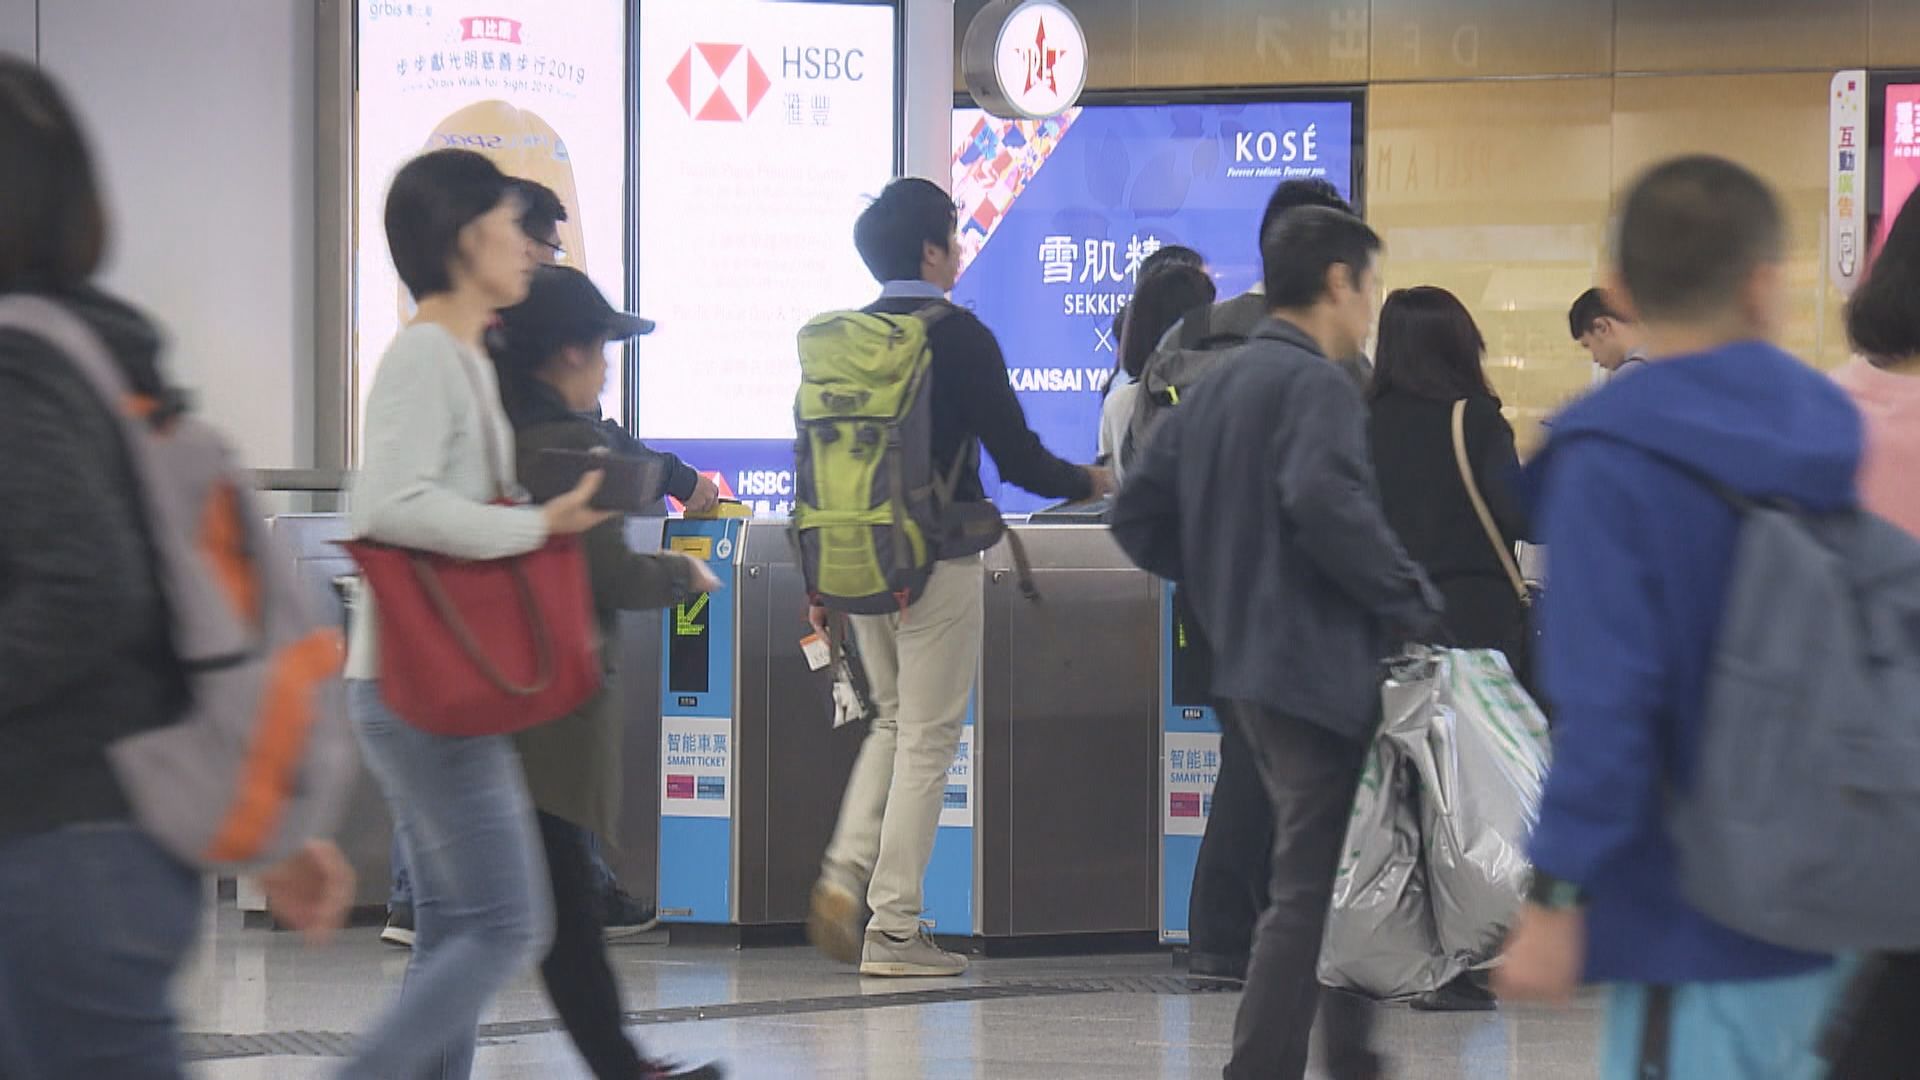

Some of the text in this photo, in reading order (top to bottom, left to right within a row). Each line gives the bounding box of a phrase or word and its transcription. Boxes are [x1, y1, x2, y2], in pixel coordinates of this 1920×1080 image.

[782, 46, 865, 81] HSBC
[1235, 122, 1318, 161] KOSÉ
[1064, 294, 1135, 315] SEKKIS
[1008, 368, 1116, 391] KANSAI YA
[738, 470, 791, 496] HSBC
[667, 733, 727, 753] 智能車票
[667, 756, 725, 767] SMART TICKET
[1170, 749, 1218, 769] 智能車
[944, 765, 968, 775] CKET
[1170, 773, 1218, 784] SMART TIC
